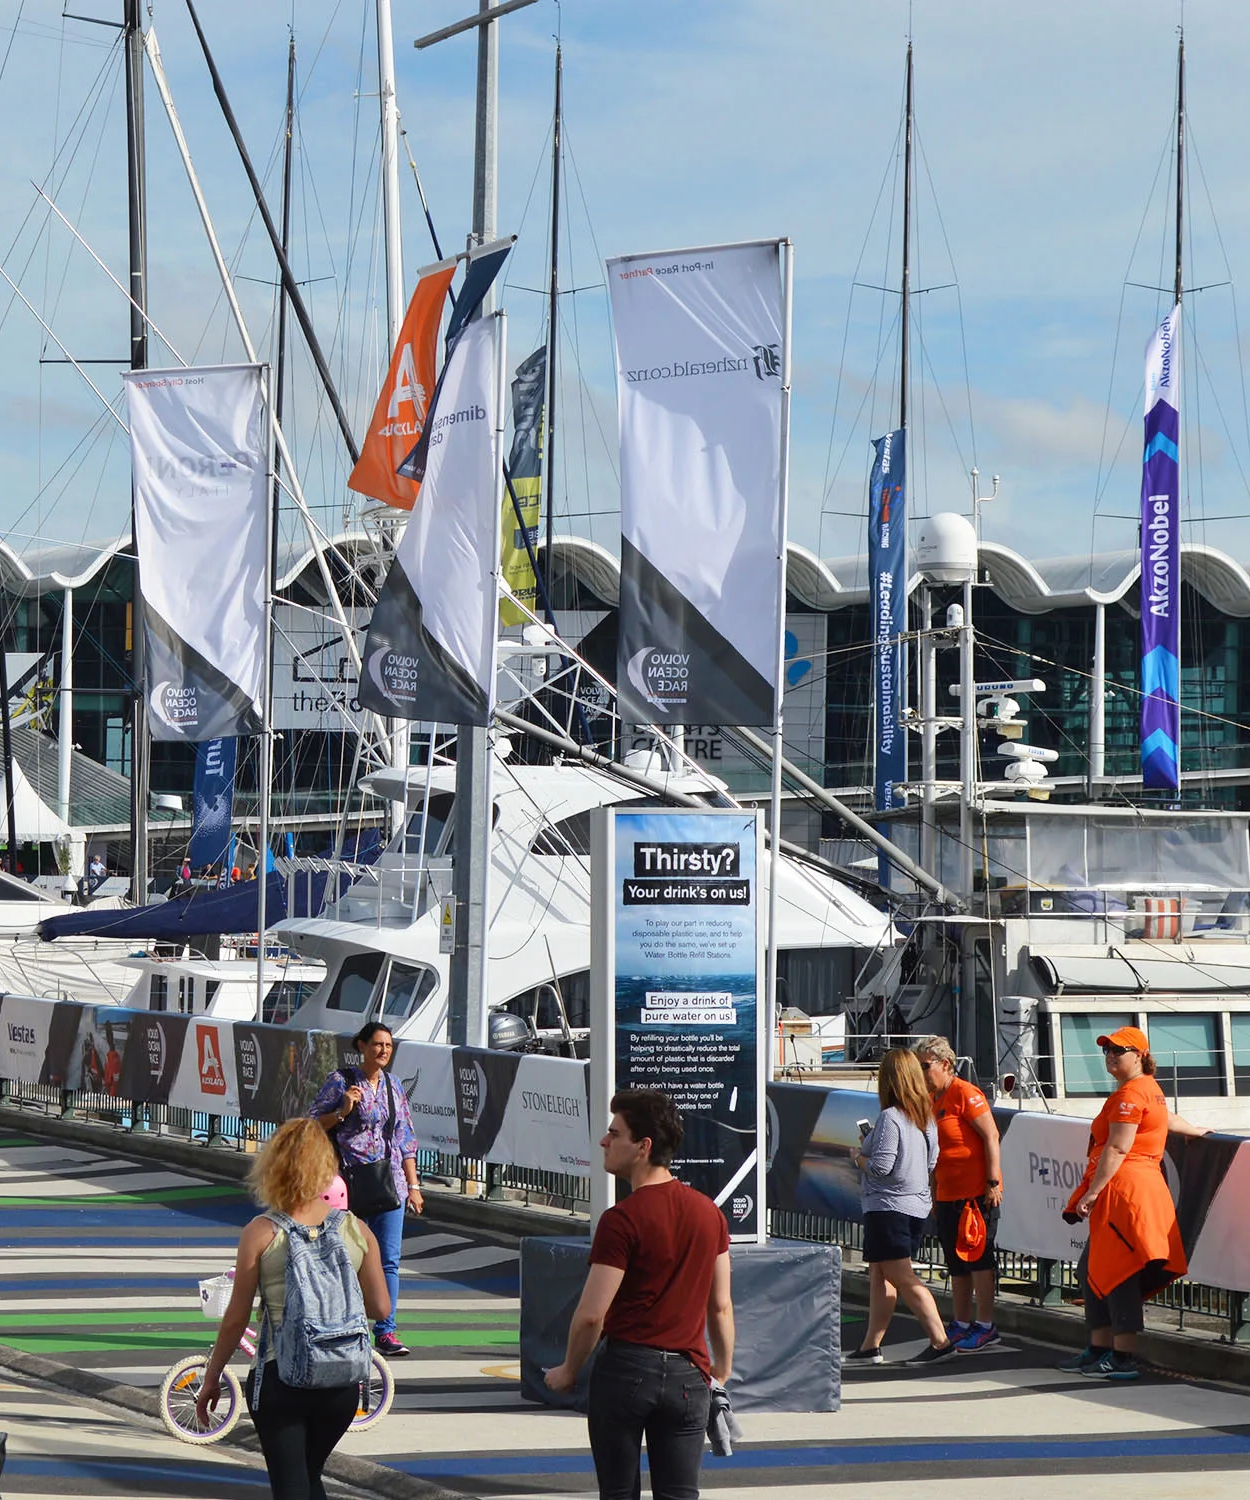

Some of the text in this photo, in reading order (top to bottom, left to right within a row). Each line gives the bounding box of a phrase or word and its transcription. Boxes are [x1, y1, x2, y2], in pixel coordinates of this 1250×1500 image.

[1160, 316, 1172, 388] AkzoNobel
[882, 432, 893, 474] Vestas
[1149, 494, 1170, 617] AkzoNobel
[879, 571, 893, 755] #LeadingSustainability
[640, 847, 735, 875] Thirsty?
[628, 886, 747, 898] Your drink's on us!
[656, 920, 669, 928] play
[684, 920, 697, 928] part
[706, 920, 732, 928] reducing
[632, 931, 669, 939] disposable
[672, 931, 693, 939] plastic
[730, 931, 742, 939] help
[650, 996, 680, 1007] Enjoy
[692, 996, 717, 1005] drink
[719, 996, 729, 1005] of
[645, 1013, 669, 1022] pure
[673, 1012, 701, 1020] water
[719, 1012, 733, 1020] us!
[7, 1022, 35, 1044] Vestas
[631, 1034, 640, 1043] By
[641, 1034, 664, 1043] refilling
[240, 1040, 254, 1051] VOLVO
[631, 1045, 654, 1053] helping
[664, 1044, 695, 1053] drastically
[344, 1053, 359, 1065] VOLVO
[665, 1055, 685, 1063] plastic
[459, 1068, 477, 1081] VOLVO
[647, 1065, 660, 1074] only
[662, 1065, 680, 1074] being
[461, 1083, 478, 1097] OCEAN
[687, 1092, 698, 1101] buy
[522, 1090, 580, 1117] STONELEIGH
